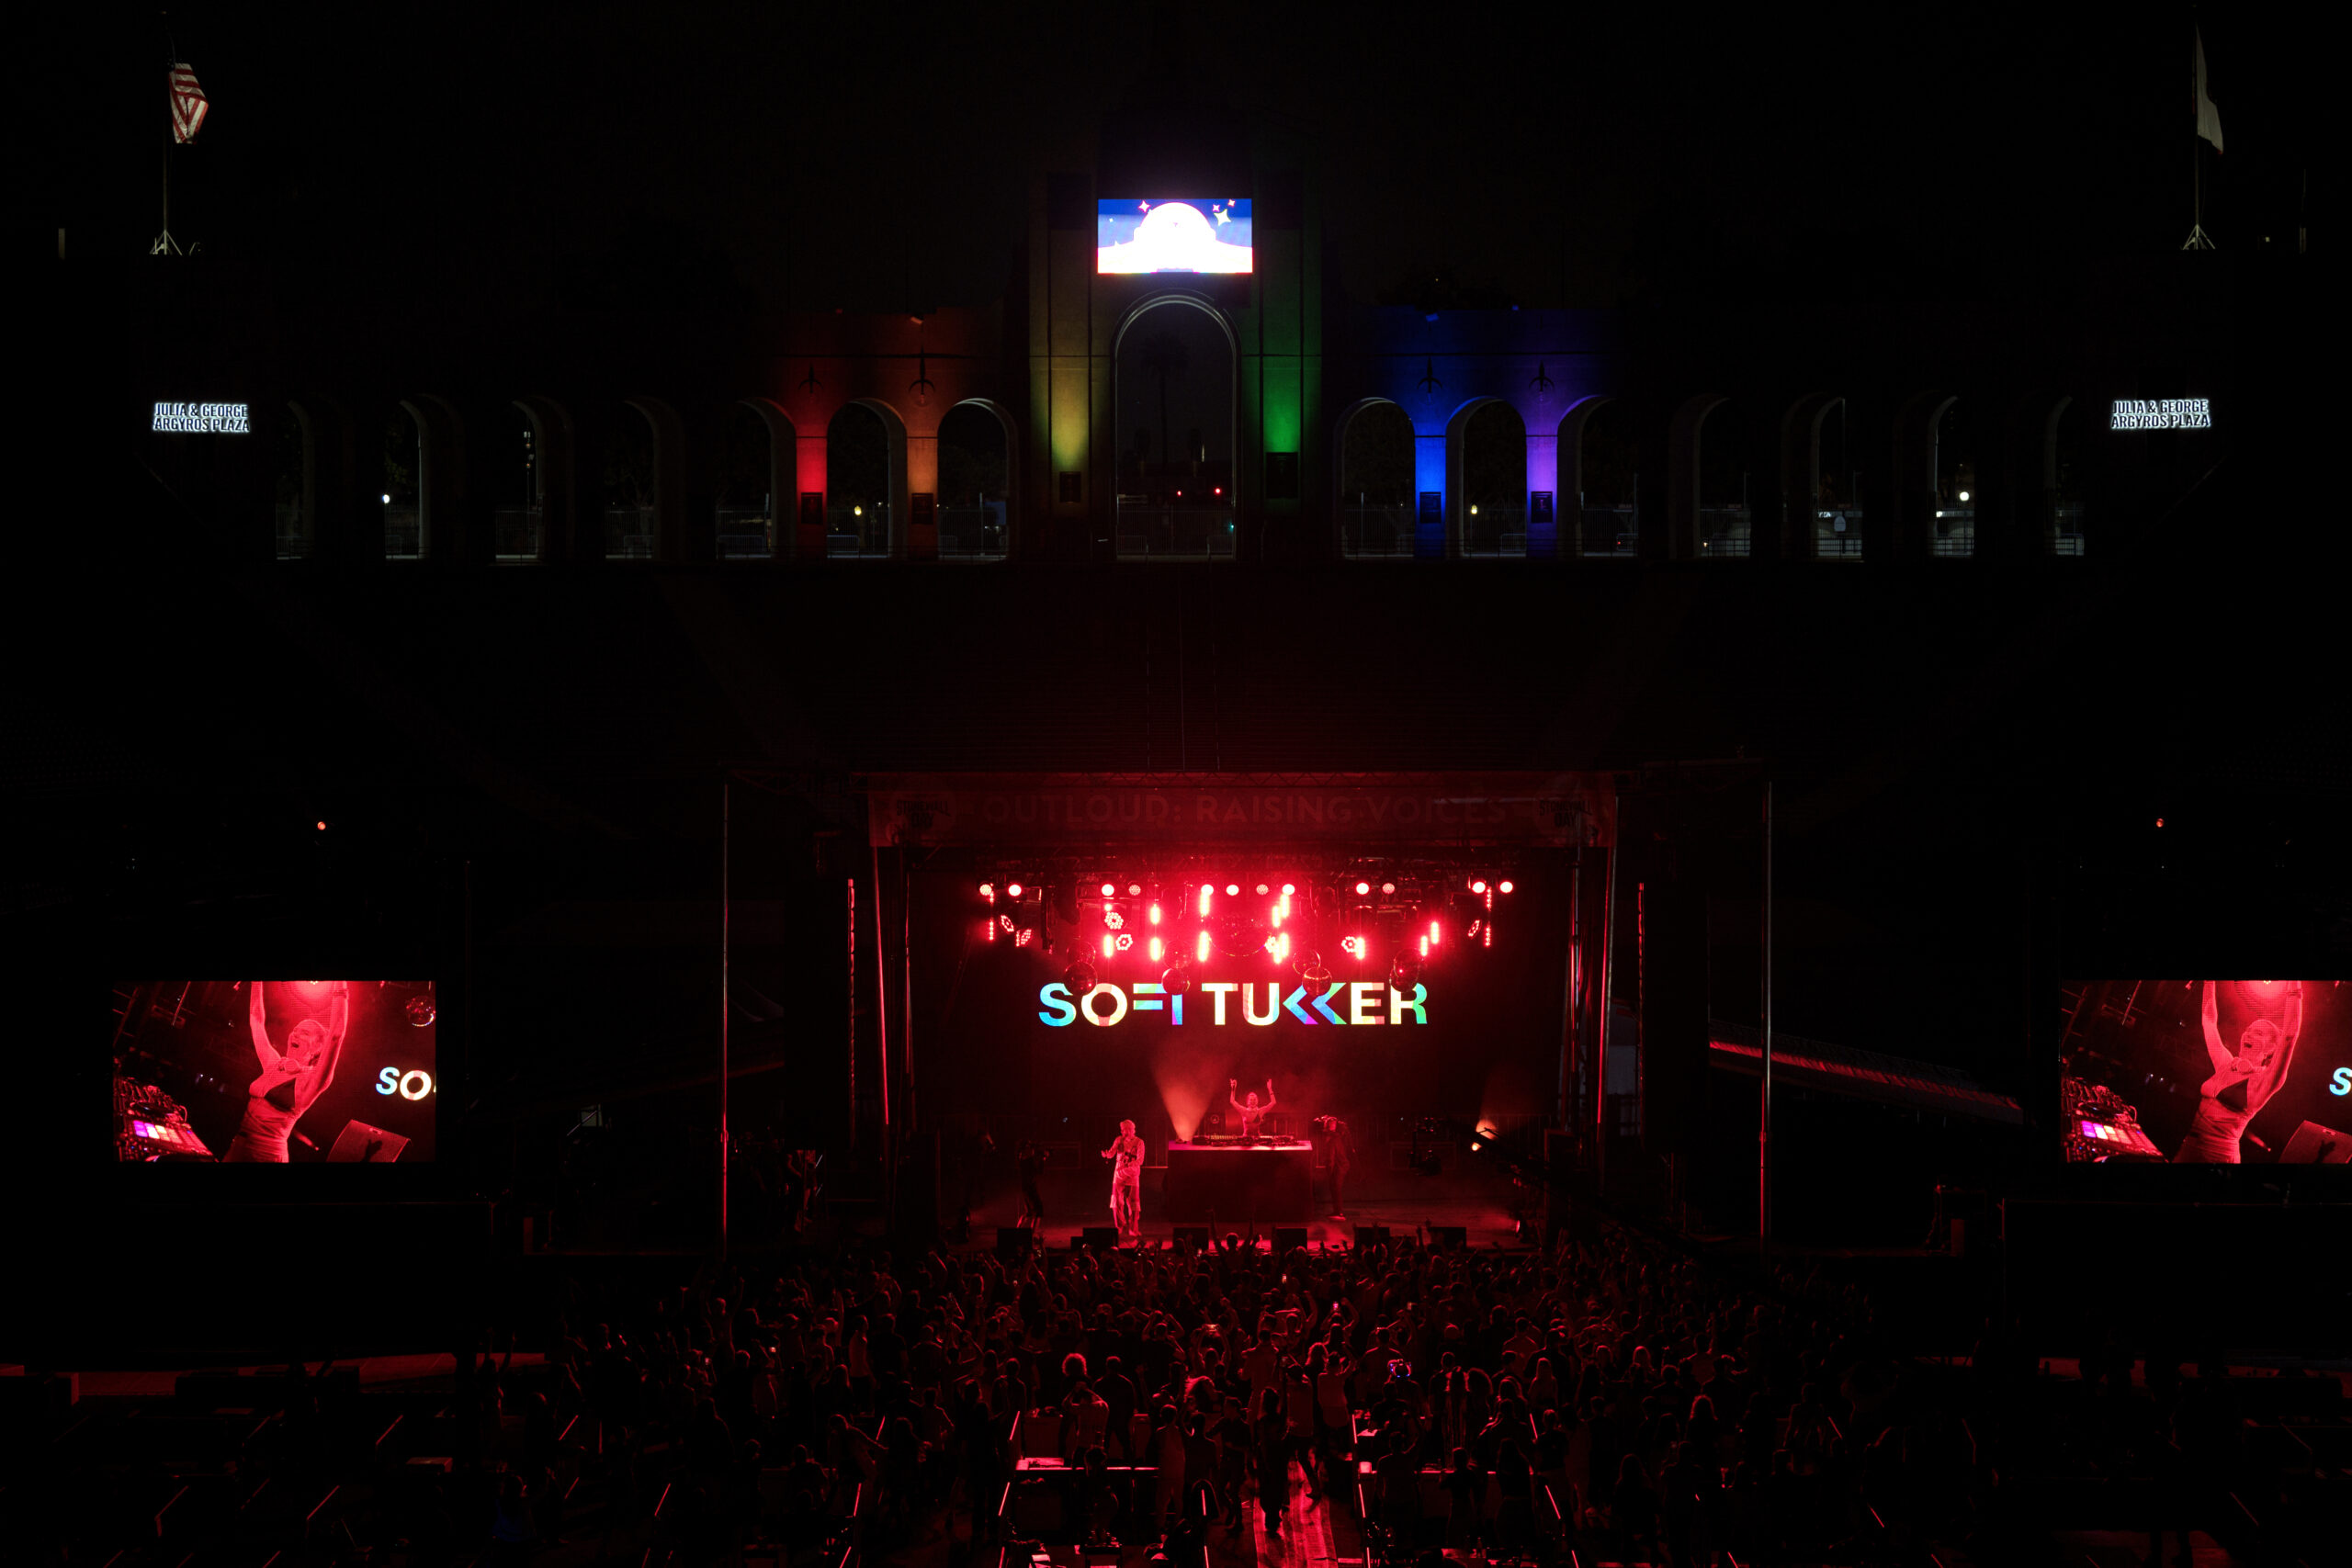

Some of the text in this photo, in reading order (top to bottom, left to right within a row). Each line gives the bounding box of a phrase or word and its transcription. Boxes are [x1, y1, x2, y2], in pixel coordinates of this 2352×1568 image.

[154, 402, 249, 419] JULIA & GEORGE
[2112, 399, 2210, 414] JULIA & GEORGE
[153, 416, 250, 433] ARGYROS PLAZA
[2110, 412, 2211, 429] ARGYROS PLAZA
[981, 793, 1507, 825] OUTLOUD: RAISING VOICES
[375, 1066, 436, 1100] SO
